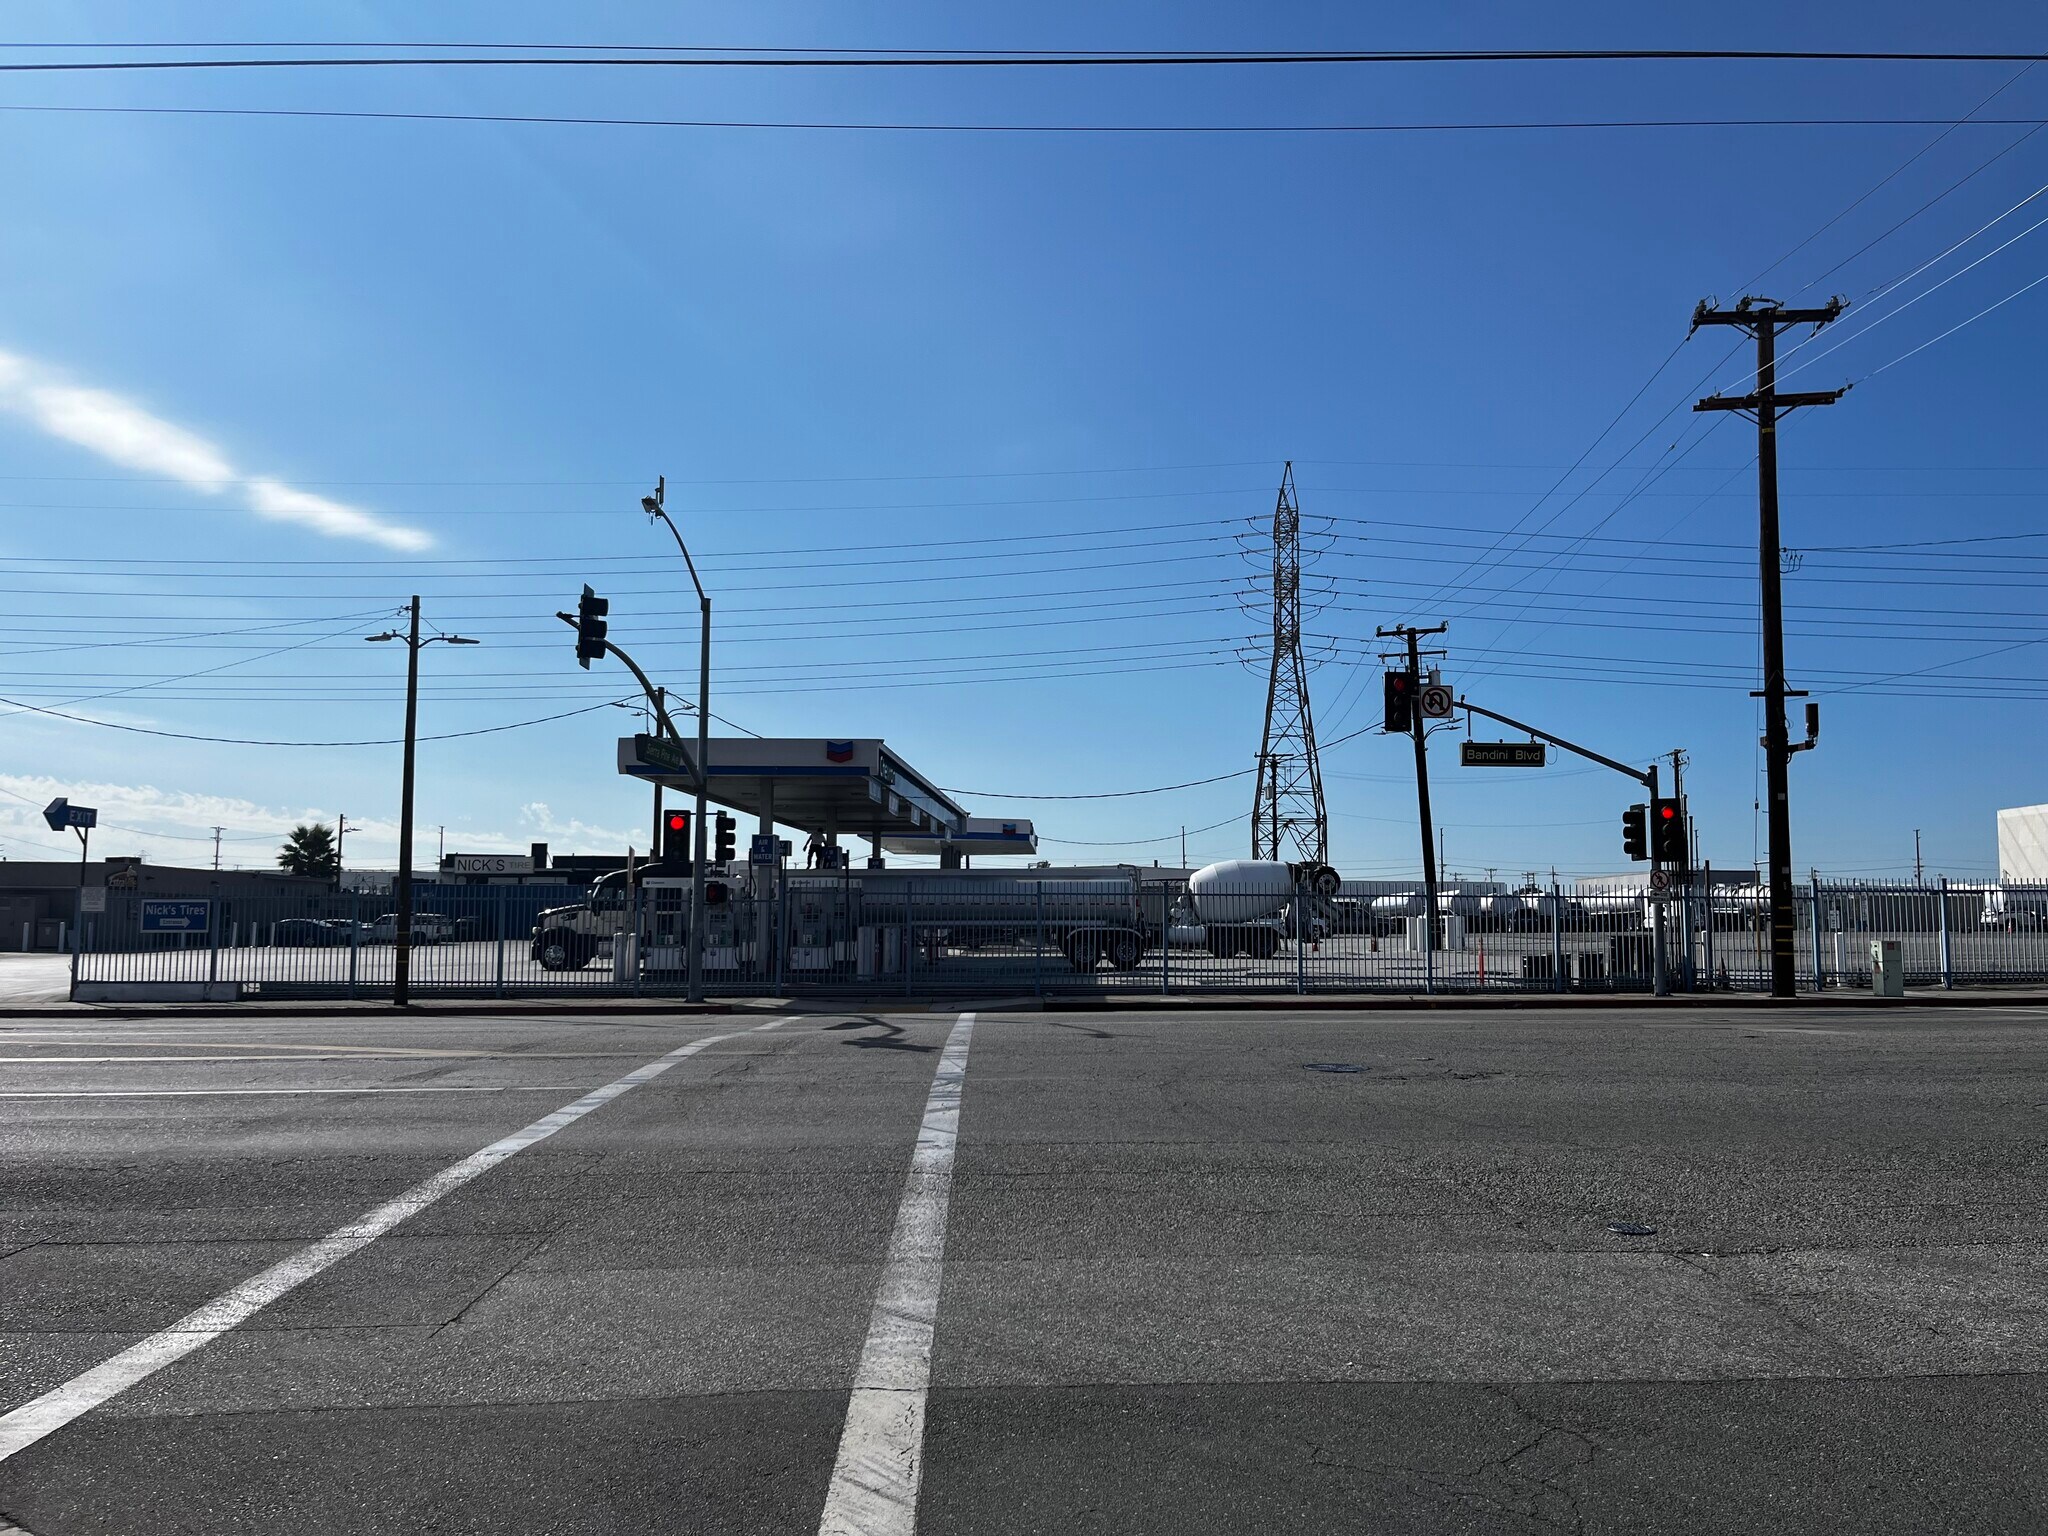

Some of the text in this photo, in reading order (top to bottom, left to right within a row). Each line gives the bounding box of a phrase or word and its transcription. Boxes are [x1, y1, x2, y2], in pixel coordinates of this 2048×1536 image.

[1466, 749, 1541, 760] Bandini Blvd
[69, 810, 93, 823] EXIT
[509, 861, 531, 869] TIRE
[146, 905, 206, 915] Nick's Tires
